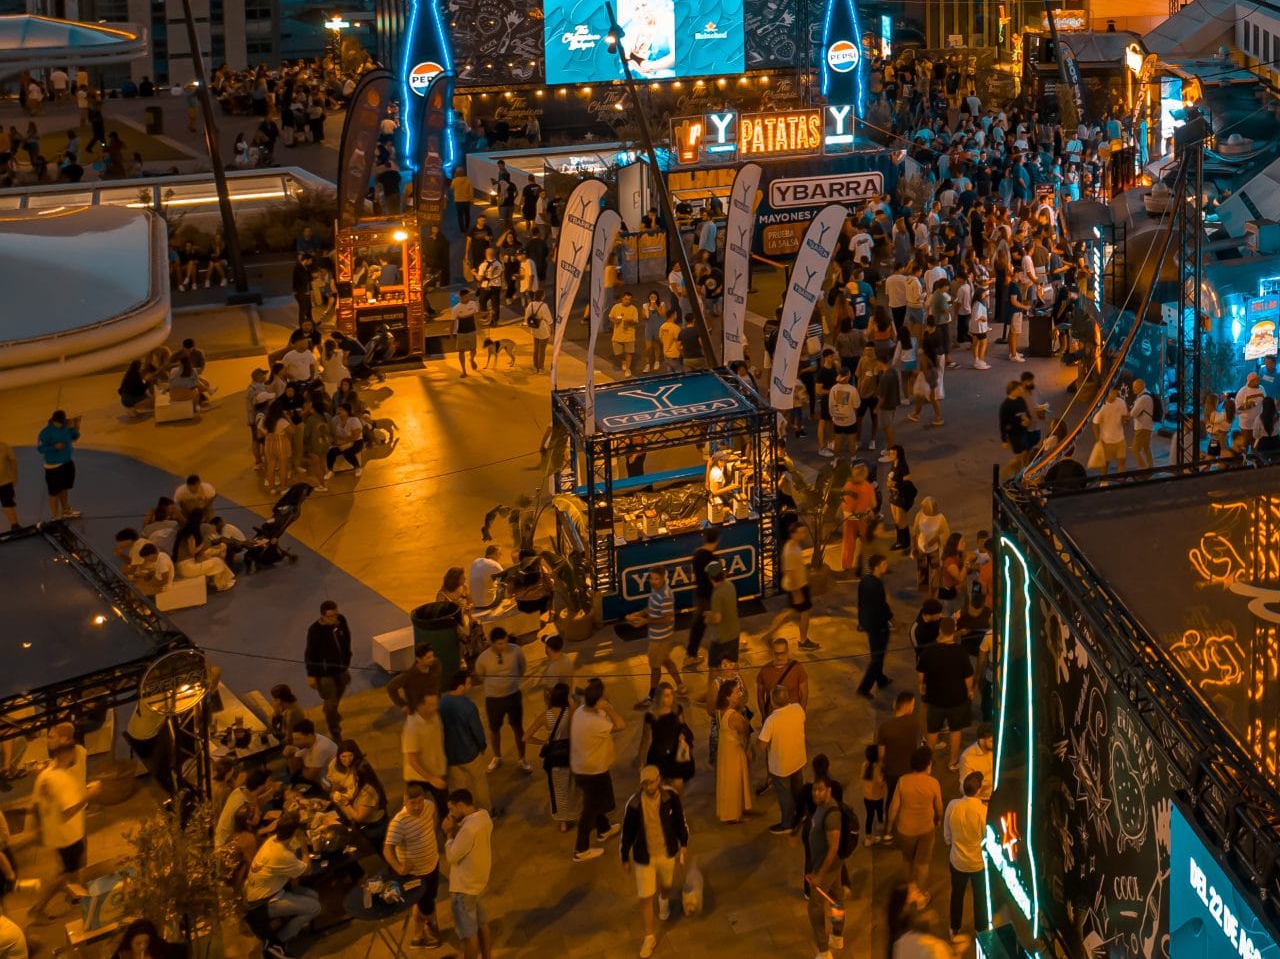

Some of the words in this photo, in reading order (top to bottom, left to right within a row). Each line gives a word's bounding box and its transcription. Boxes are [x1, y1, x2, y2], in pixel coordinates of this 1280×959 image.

[830, 52, 857, 61] PEPSI
[411, 75, 434, 84] PEP
[741, 115, 821, 154] PATATAS
[775, 178, 880, 202] YBARRA
[613, 401, 728, 424] YBARRA
[1114, 875, 1144, 902] COOL
[1189, 856, 1209, 908] DEL
[1223, 904, 1239, 949] DE
